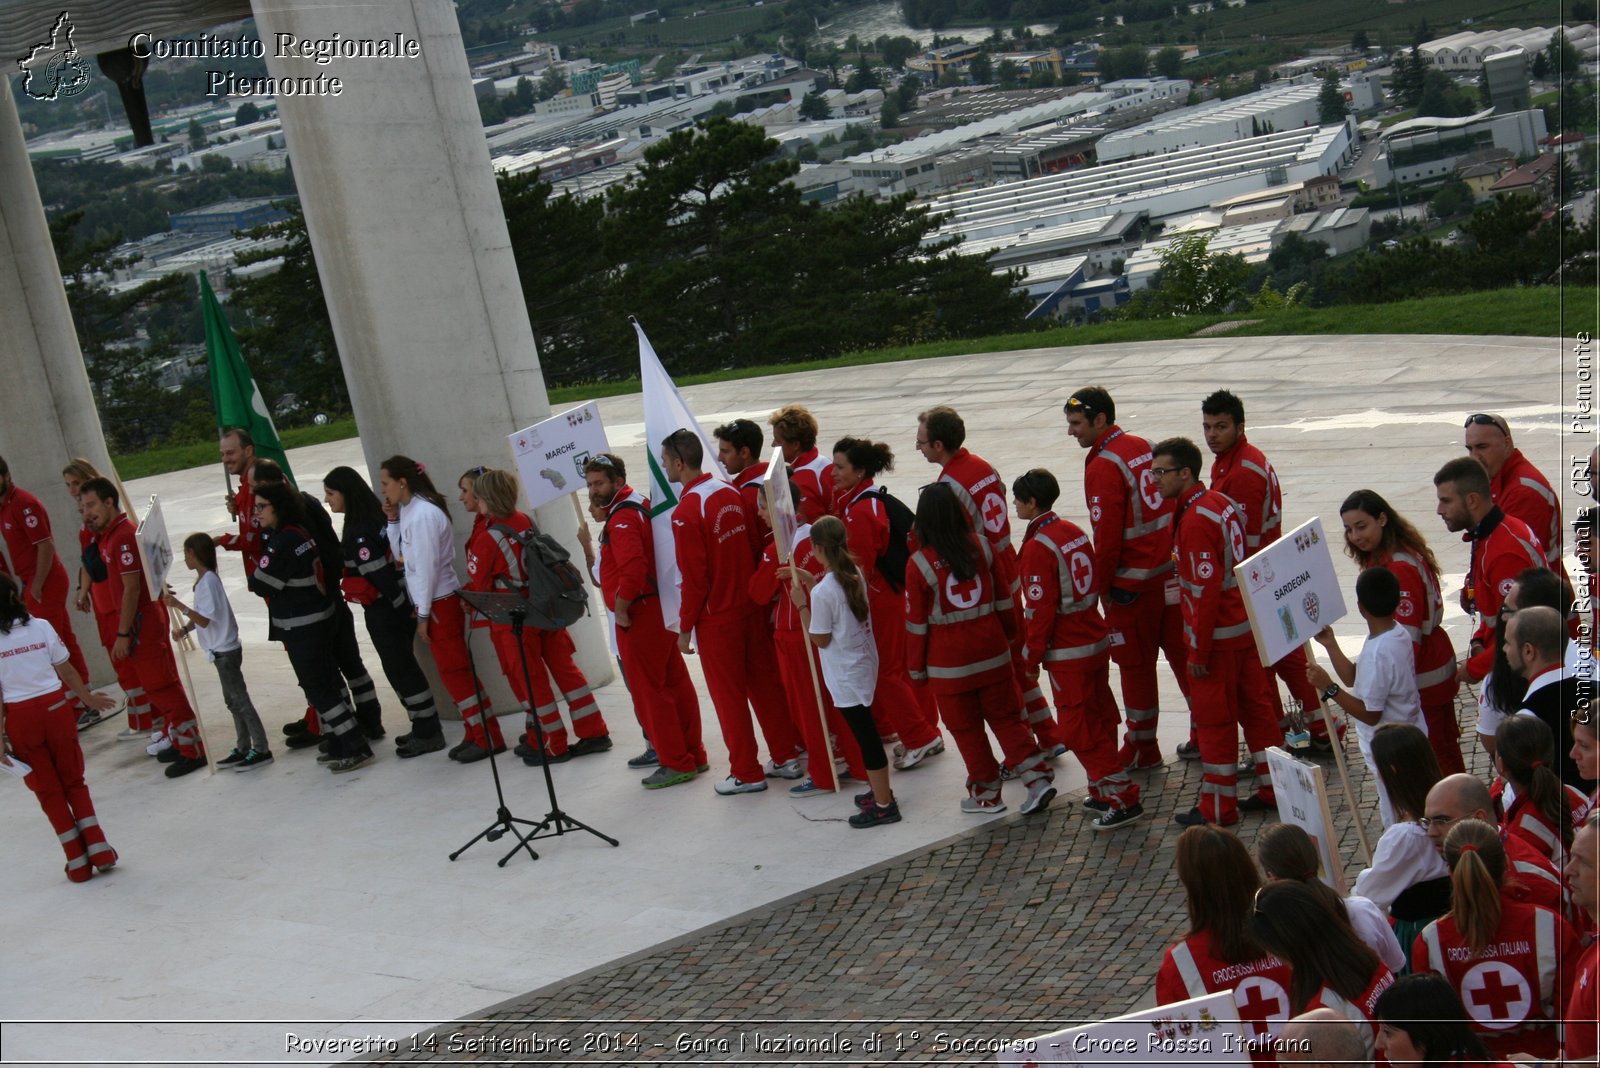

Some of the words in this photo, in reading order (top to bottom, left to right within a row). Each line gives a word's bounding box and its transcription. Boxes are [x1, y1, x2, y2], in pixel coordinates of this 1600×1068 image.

[545, 441, 577, 461] MARCHE
[1273, 570, 1311, 601] SARDEGNA
[1499, 940, 1531, 957] ITALIANA
[1212, 965, 1237, 985] CROCE
